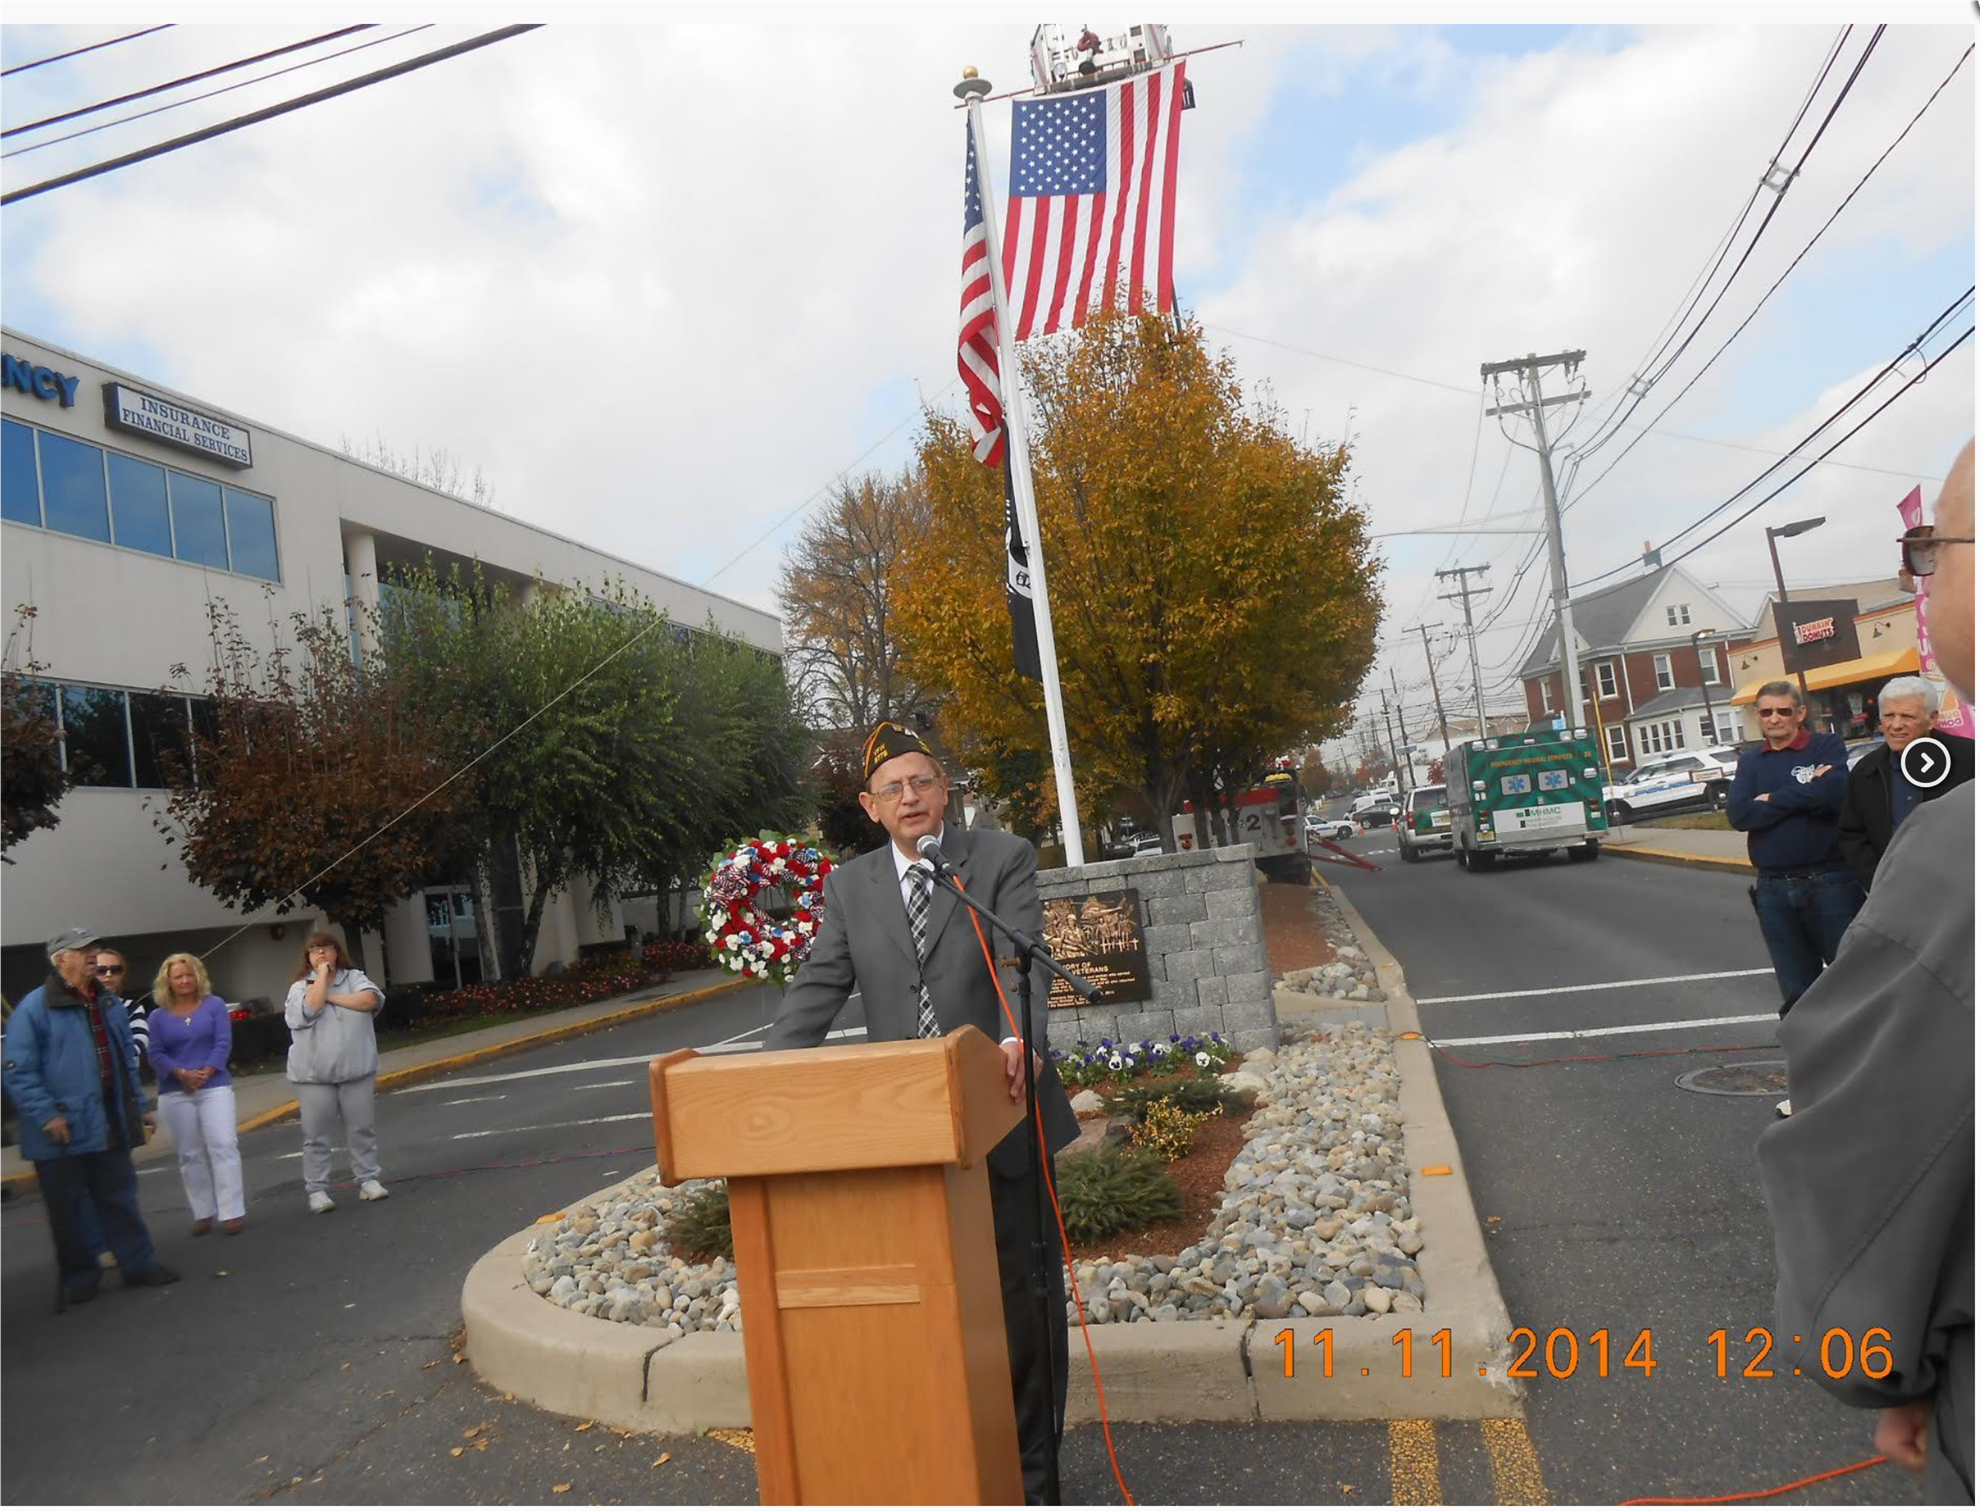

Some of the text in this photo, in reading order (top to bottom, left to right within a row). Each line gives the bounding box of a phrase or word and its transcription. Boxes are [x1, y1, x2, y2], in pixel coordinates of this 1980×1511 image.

[0, 352, 80, 408] NCY
[140, 397, 230, 440] INSURANCE
[122, 408, 248, 461] FINANCIAL SERVICES
[1803, 627, 1833, 642] DONUTS
[1246, 814, 1261, 831] 2
[1071, 965, 1109, 974] VETERANS
